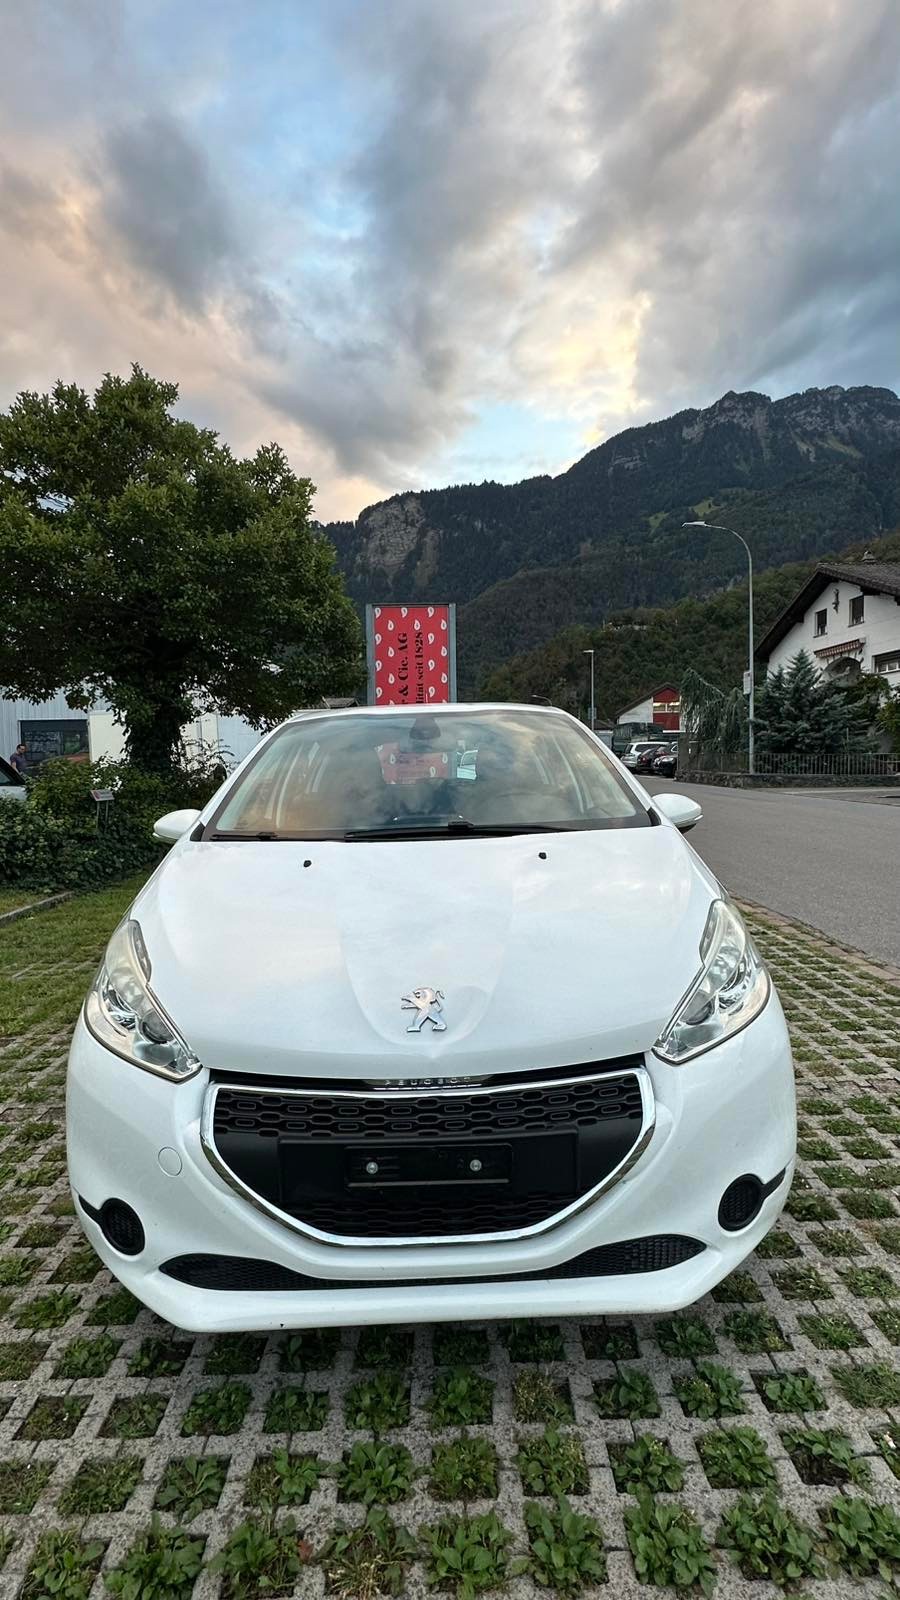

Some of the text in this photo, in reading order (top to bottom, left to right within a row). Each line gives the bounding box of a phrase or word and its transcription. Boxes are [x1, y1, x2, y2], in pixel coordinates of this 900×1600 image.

[398, 632, 408, 653] AG
[415, 632, 424, 658] 1828
[398, 656, 408, 681] Cie.
[415, 662, 424, 681] seit
[398, 684, 408, 696] &
